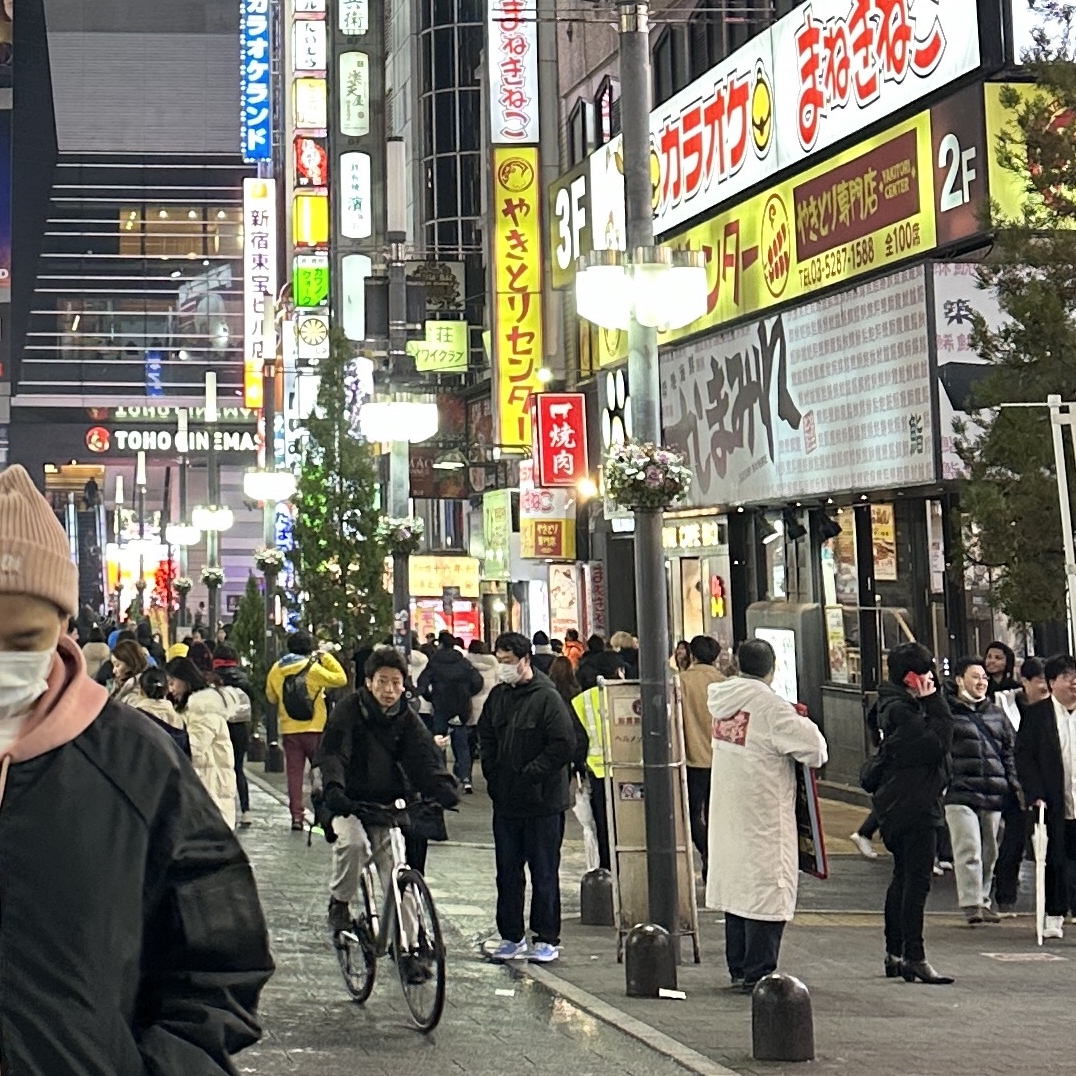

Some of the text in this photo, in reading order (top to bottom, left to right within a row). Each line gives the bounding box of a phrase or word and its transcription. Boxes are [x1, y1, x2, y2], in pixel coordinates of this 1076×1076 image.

[246, 0, 269, 151] カラオケランド
[500, 0, 529, 137] まねきねこ
[796, 0, 944, 147] まねきねこ
[660, 78, 750, 202] カラオケ
[938, 133, 978, 214] 2F
[555, 175, 586, 270] 3F
[797, 166, 878, 245] やきとり専門店
[501, 197, 536, 441] やきとりセンター
[115, 430, 171, 450] TOHO
[549, 422, 577, 475] 焼肉
